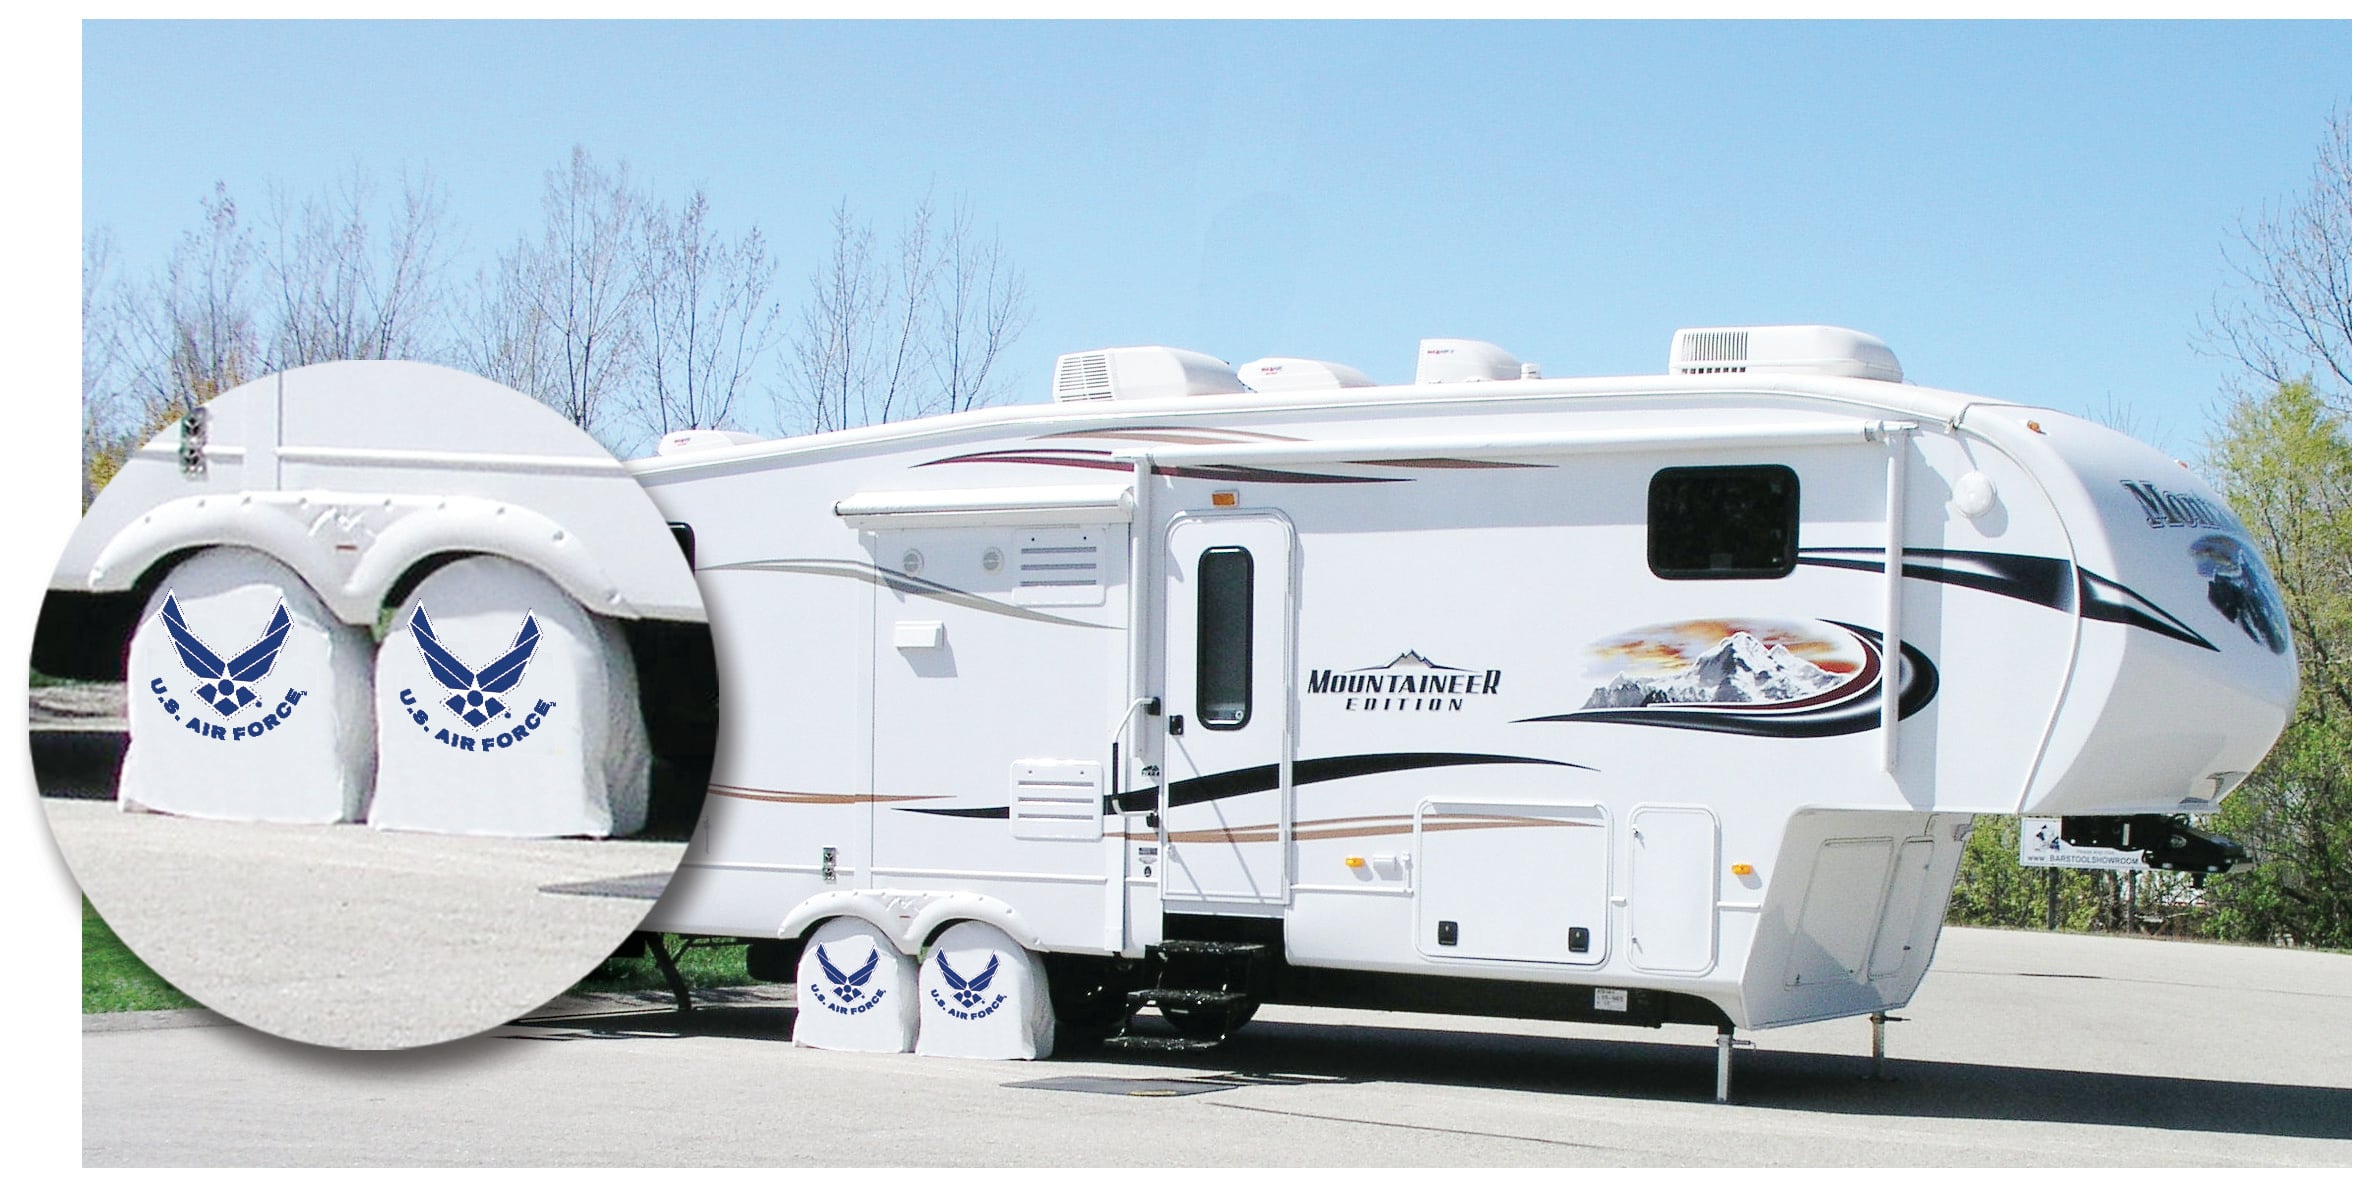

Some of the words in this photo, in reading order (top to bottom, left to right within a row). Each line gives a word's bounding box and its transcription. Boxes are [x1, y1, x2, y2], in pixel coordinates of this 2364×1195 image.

[151, 677, 181, 721] U.S.
[186, 718, 227, 741] AIR
[233, 687, 302, 741] FORCE
[400, 688, 430, 732] U.S.
[435, 729, 476, 752] AIR
[482, 698, 551, 752] FORCE
[1345, 698, 1463, 711] EDITION
[810, 983, 826, 1006] U.S.
[827, 1002, 848, 1015] AIR
[850, 988, 885, 1015] FORCE
[930, 989, 946, 1011] U.S.
[947, 1008, 968, 1020] AIR
[970, 993, 1005, 1020] FORCE
